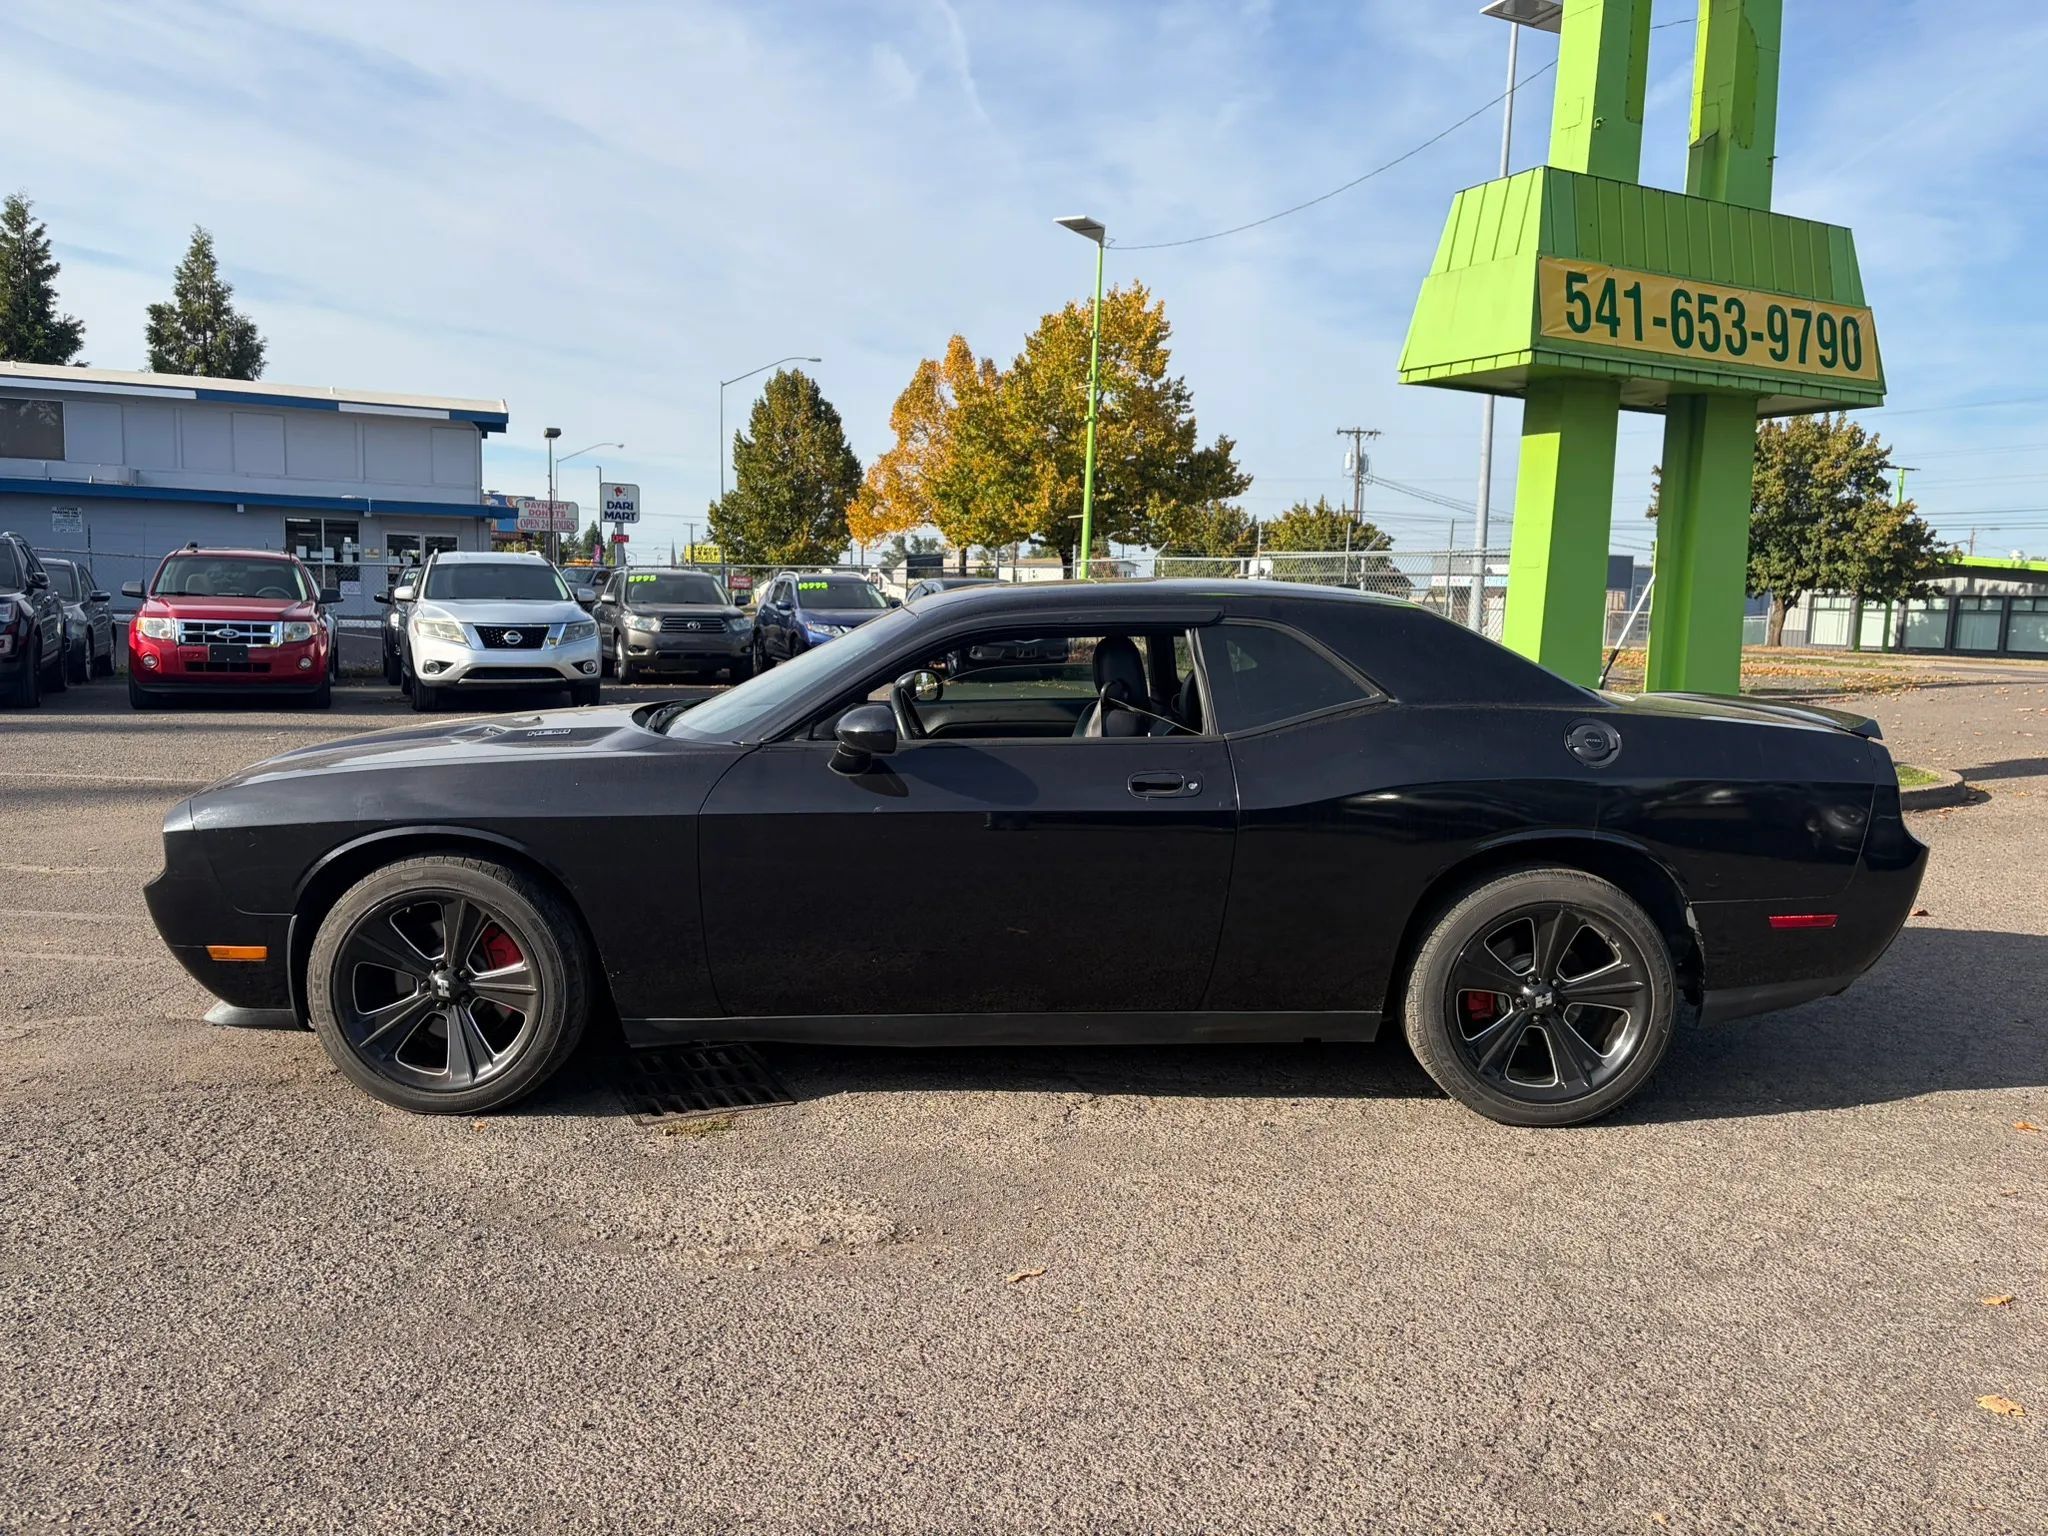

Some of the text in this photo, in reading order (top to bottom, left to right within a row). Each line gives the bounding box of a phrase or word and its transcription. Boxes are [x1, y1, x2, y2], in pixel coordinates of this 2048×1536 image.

[1566, 271, 1862, 371] 541-653-9790
[607, 501, 634, 510] DARI
[604, 511, 637, 521] MART
[520, 519, 540, 529] OPEN
